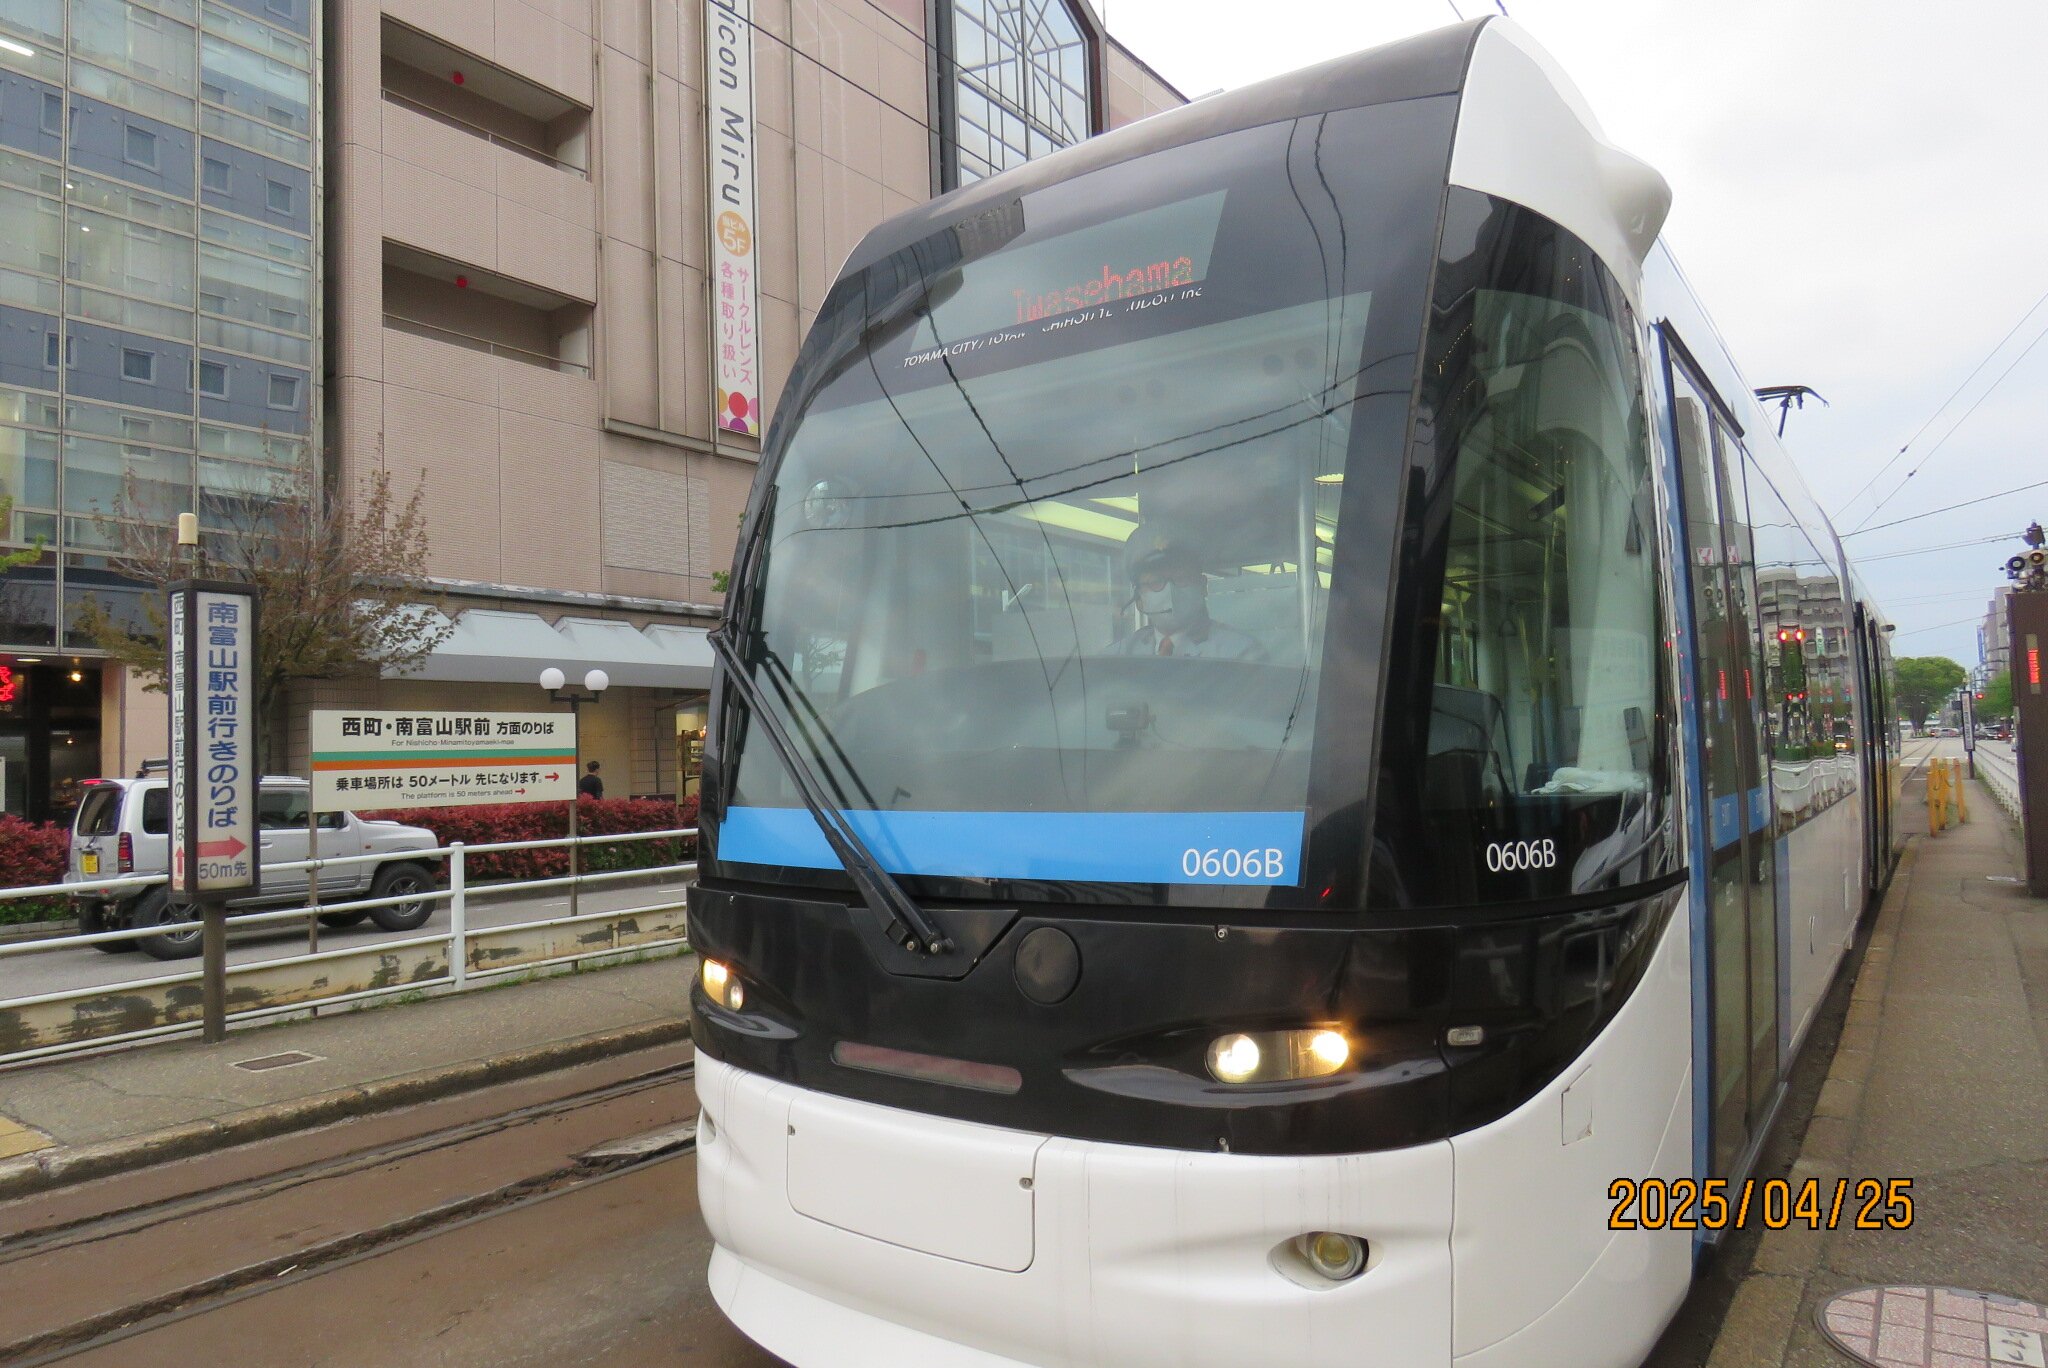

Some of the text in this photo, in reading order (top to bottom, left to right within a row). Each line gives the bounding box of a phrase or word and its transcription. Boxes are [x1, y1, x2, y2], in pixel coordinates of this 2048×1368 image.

[720, 106, 745, 206] Miru
[723, 228, 746, 253] 5F
[720, 261, 737, 379] 各種取り扱い
[737, 267, 752, 385] サークルレンズ
[904, 347, 948, 368] TOYAMA
[208, 602, 239, 829] 南富山駅前行きのりば
[342, 717, 554, 736] 西町・南富山駅前 方面のりば
[391, 739, 404, 747] For
[336, 771, 542, 791] 乗車場所は 50メートル 先になります。
[401, 792, 415, 800] The
[416, 791, 447, 800] platform
[493, 788, 513, 796] ahead
[1182, 848, 1284, 878] 0606B
[1486, 838, 1556, 872] 0606B
[199, 861, 248, 880] 50m先
